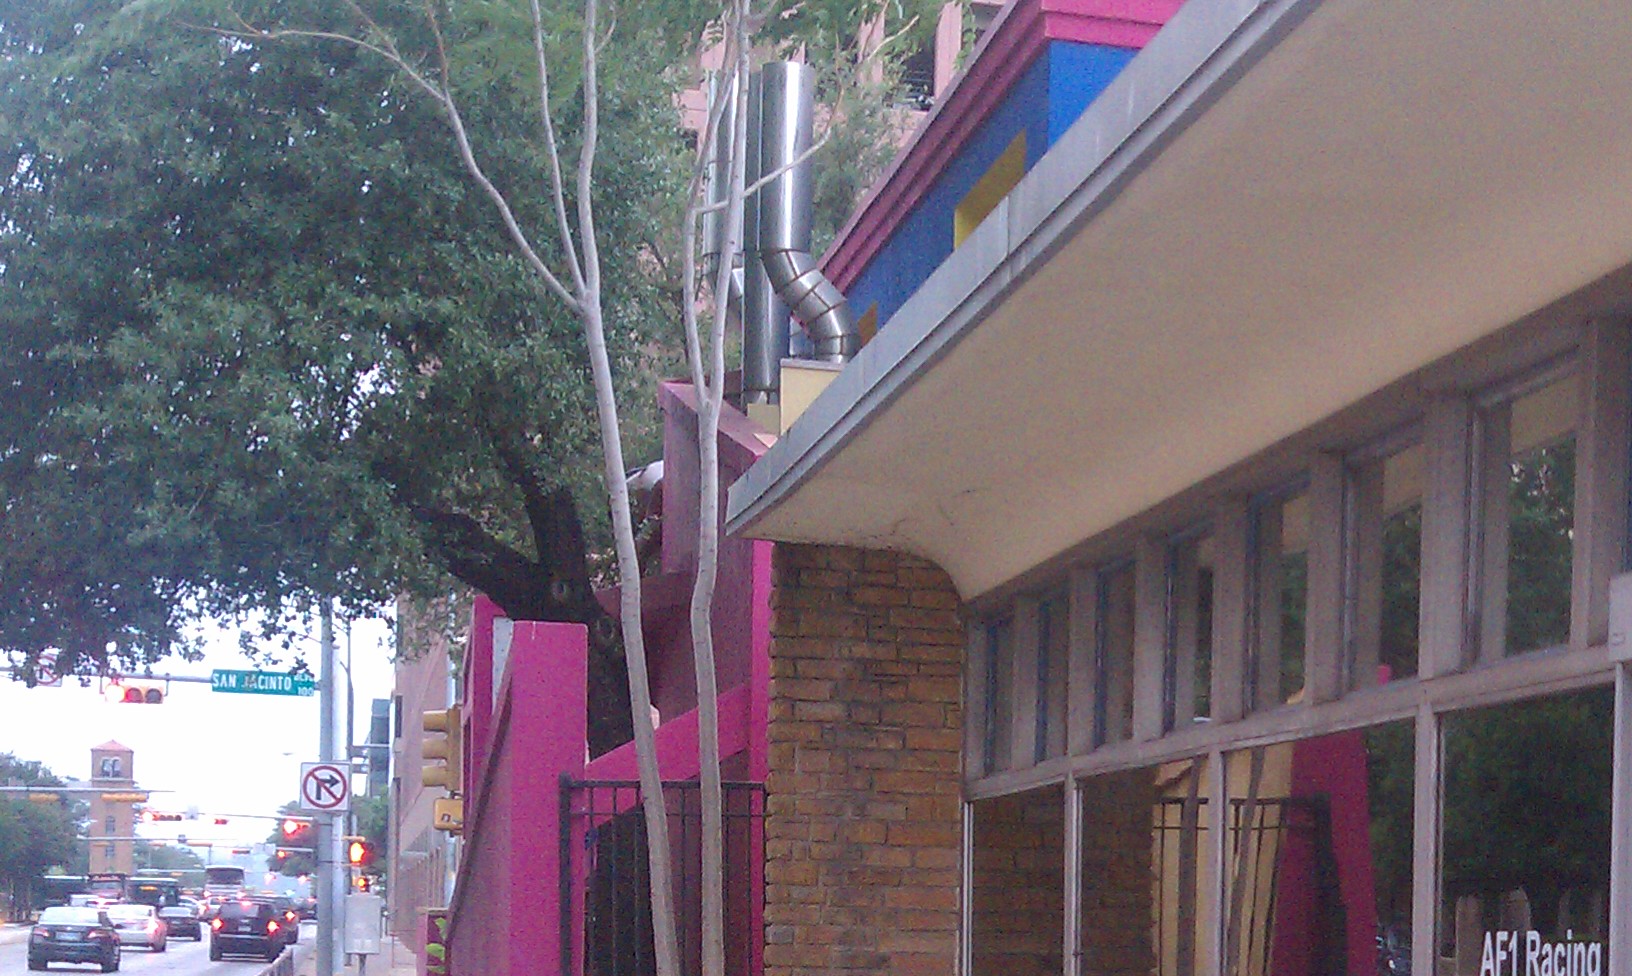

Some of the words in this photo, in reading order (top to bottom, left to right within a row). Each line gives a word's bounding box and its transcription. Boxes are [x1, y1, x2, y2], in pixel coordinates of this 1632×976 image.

[212, 673, 236, 688] SAN
[241, 674, 292, 691] JACINTO
[297, 686, 314, 697] 100
